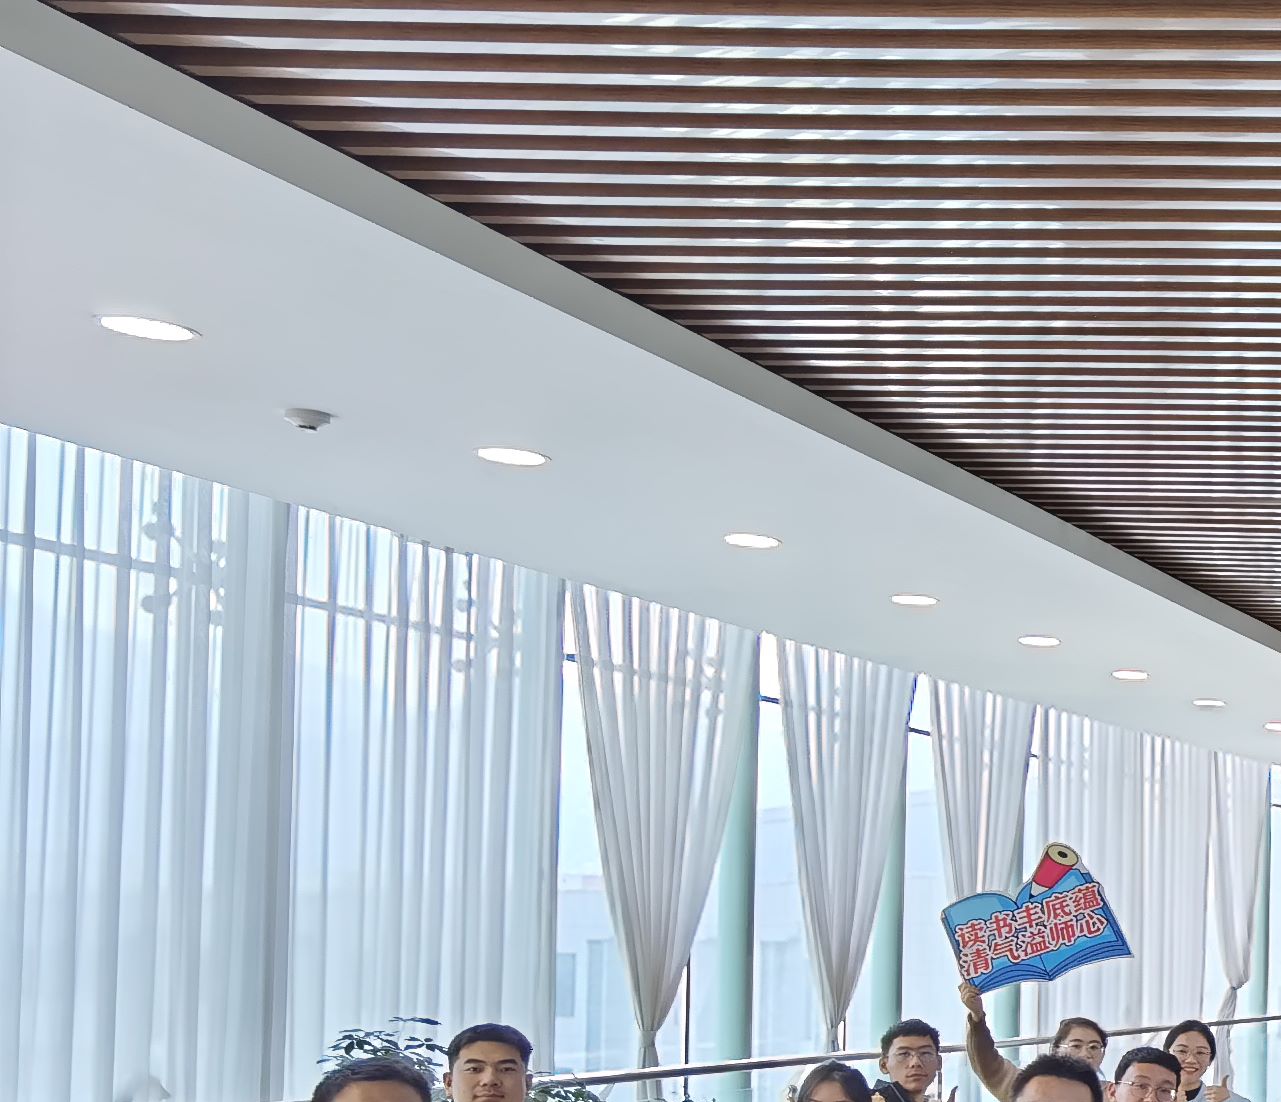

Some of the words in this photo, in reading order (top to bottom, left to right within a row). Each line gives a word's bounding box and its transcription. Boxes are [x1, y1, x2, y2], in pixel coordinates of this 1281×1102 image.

[955, 883, 1103, 948] 读书丰底蕴
[960, 912, 1107, 978] 清气溢师心
